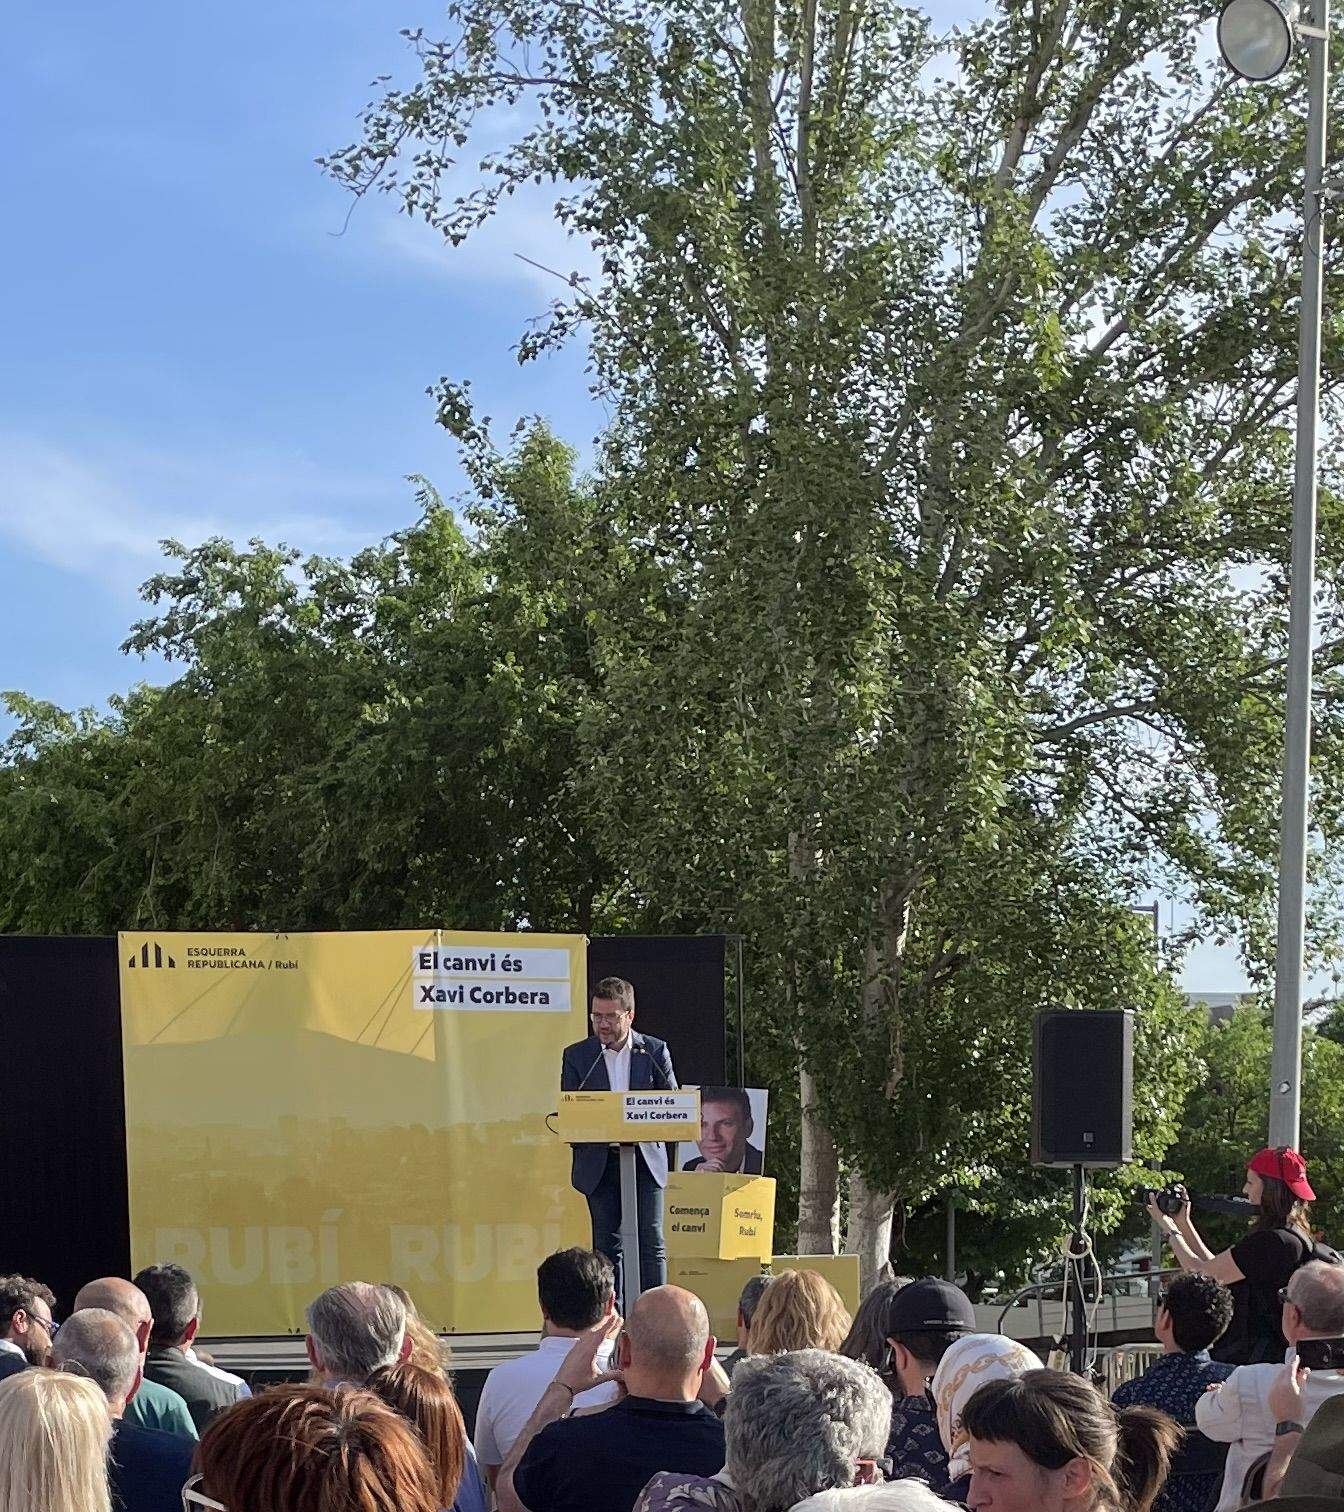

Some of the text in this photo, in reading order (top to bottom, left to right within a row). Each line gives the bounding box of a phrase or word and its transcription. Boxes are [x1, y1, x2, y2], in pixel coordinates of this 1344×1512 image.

[187, 947, 246, 957] ESQUERRA
[187, 959, 265, 969] REPUBLICANA
[275, 959, 299, 970] Rubí
[419, 952, 523, 972] El canvi és
[420, 984, 550, 1005] Xavi Corbera
[626, 1096, 675, 1106] El canvi és
[626, 1111, 688, 1120] Xavi Corbera
[669, 1205, 710, 1218] Comença
[671, 1222, 706, 1233] el canvi
[155, 1208, 344, 1286] RUBÍ
